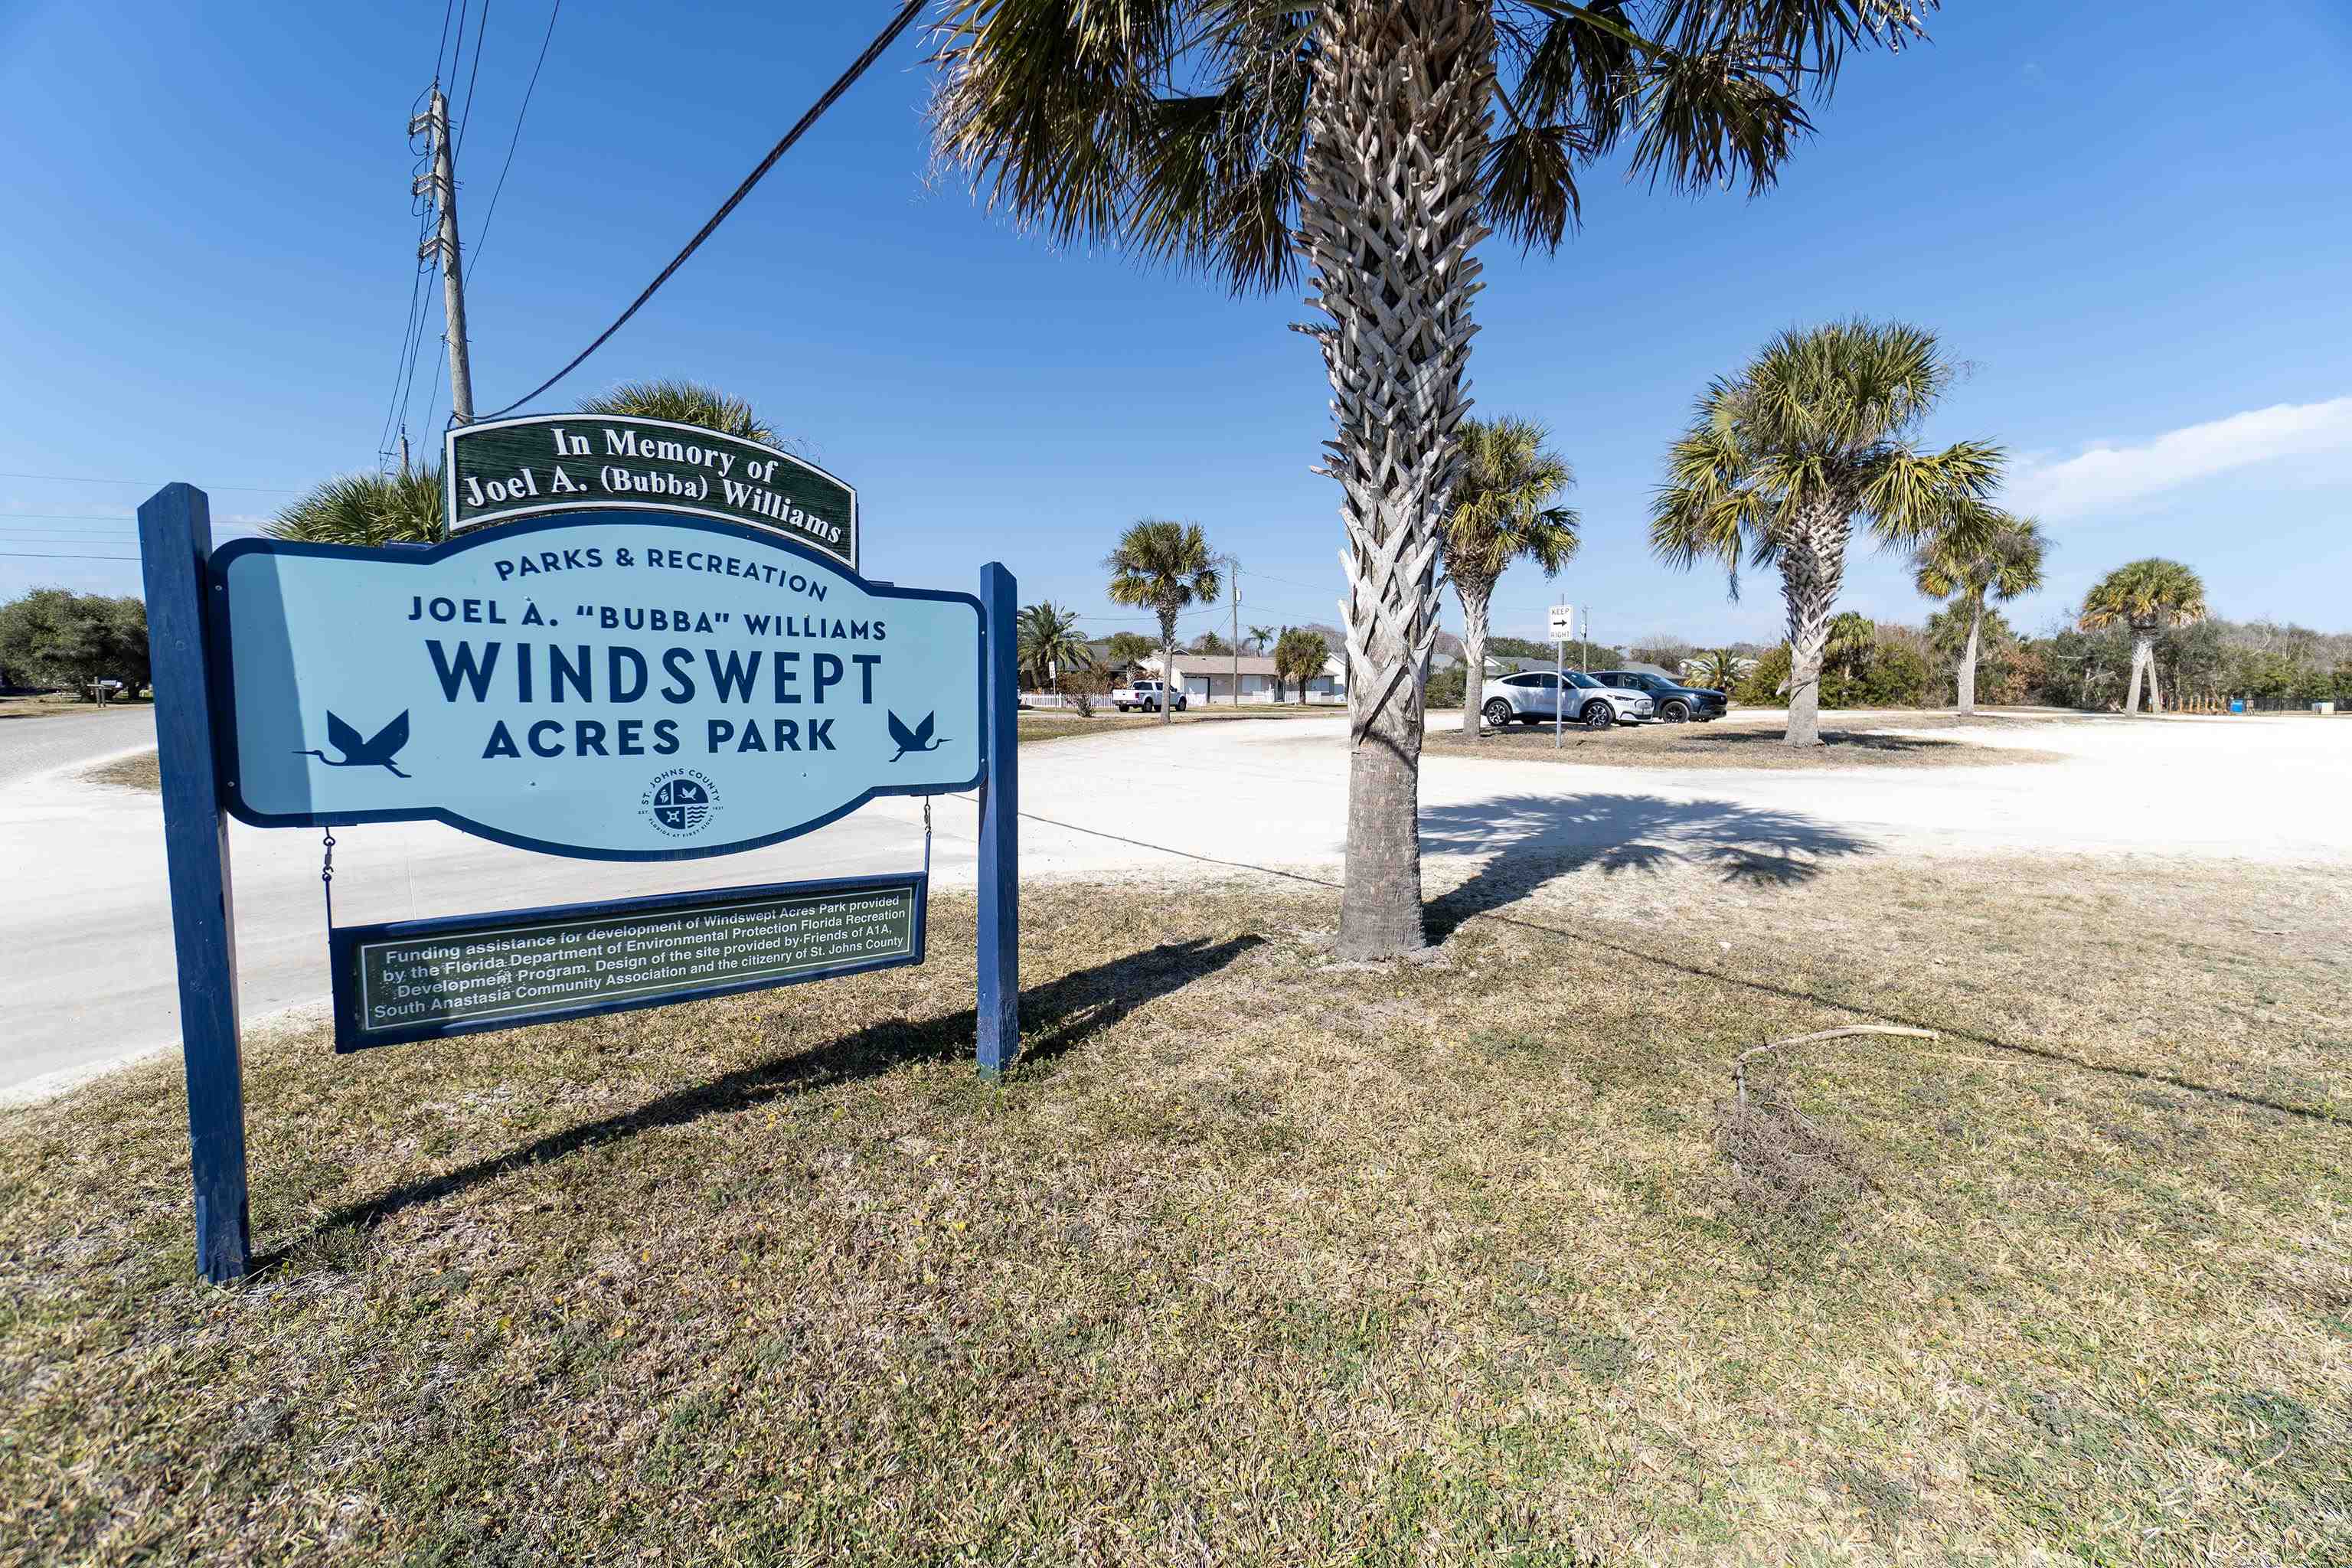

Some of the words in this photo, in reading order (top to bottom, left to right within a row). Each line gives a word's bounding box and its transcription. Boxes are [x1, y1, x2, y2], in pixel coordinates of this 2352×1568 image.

[550, 428, 593, 457] In
[606, 428, 736, 478] Memory
[747, 456, 778, 484] of
[464, 469, 540, 508] Joel
[550, 466, 587, 494] A.
[600, 465, 709, 501] (Bubba)
[723, 479, 843, 545] Williams
[494, 547, 603, 582] PARKS
[616, 547, 635, 567] &
[647, 547, 828, 602] RECREATION
[408, 596, 507, 625] JOEL
[521, 602, 559, 627] A.
[743, 614, 887, 641] WILLIAMS
[1551, 607, 1570, 616] KEEP
[425, 639, 882, 705] WINDSWEPT
[482, 718, 681, 760] ACRES
[707, 717, 838, 754] PARK
[642, 791, 652, 805] ST.
[649, 768, 684, 789] JOHNS
[688, 769, 720, 802] COUNTY
[383, 969, 405, 984] by
[411, 965, 440, 978] the
[445, 956, 505, 975] Florida
[511, 946, 603, 967] Department
[607, 942, 622, 955] of
[626, 929, 728, 952] Environmental
[733, 923, 797, 939] Protection
[802, 916, 842, 931] Florida
[846, 910, 905, 925] Recreation
[386, 946, 460, 964] Funding
[466, 935, 556, 956] assistance
[560, 933, 583, 944] for
[586, 921, 682, 941] development
[686, 918, 700, 929] of
[704, 910, 776, 927] Windswept
[779, 906, 815, 919] Acres
[819, 902, 846, 914] Park
[849, 896, 900, 913] provided
[374, 1000, 425, 1018] South
[430, 989, 511, 1011] Anastasia
[516, 978, 602, 999] Community
[606, 965, 687, 986] Association
[691, 961, 714, 974] and
[717, 959, 738, 970] the
[741, 952, 792, 968] citizenry
[795, 949, 808, 959] of
[811, 946, 825, 958] St.
[828, 942, 863, 956] Johns
[866, 936, 903, 949] County
[397, 972, 513, 998] Development
[518, 964, 590, 982] Program.
[596, 956, 646, 972] Design
[652, 953, 666, 965] of
[670, 950, 692, 962] the
[695, 946, 720, 959] site
[724, 937, 781, 957] provided
[785, 936, 800, 948] by
[804, 931, 848, 944] Friends
[851, 927, 864, 938] of
[866, 924, 892, 936] A1A,
